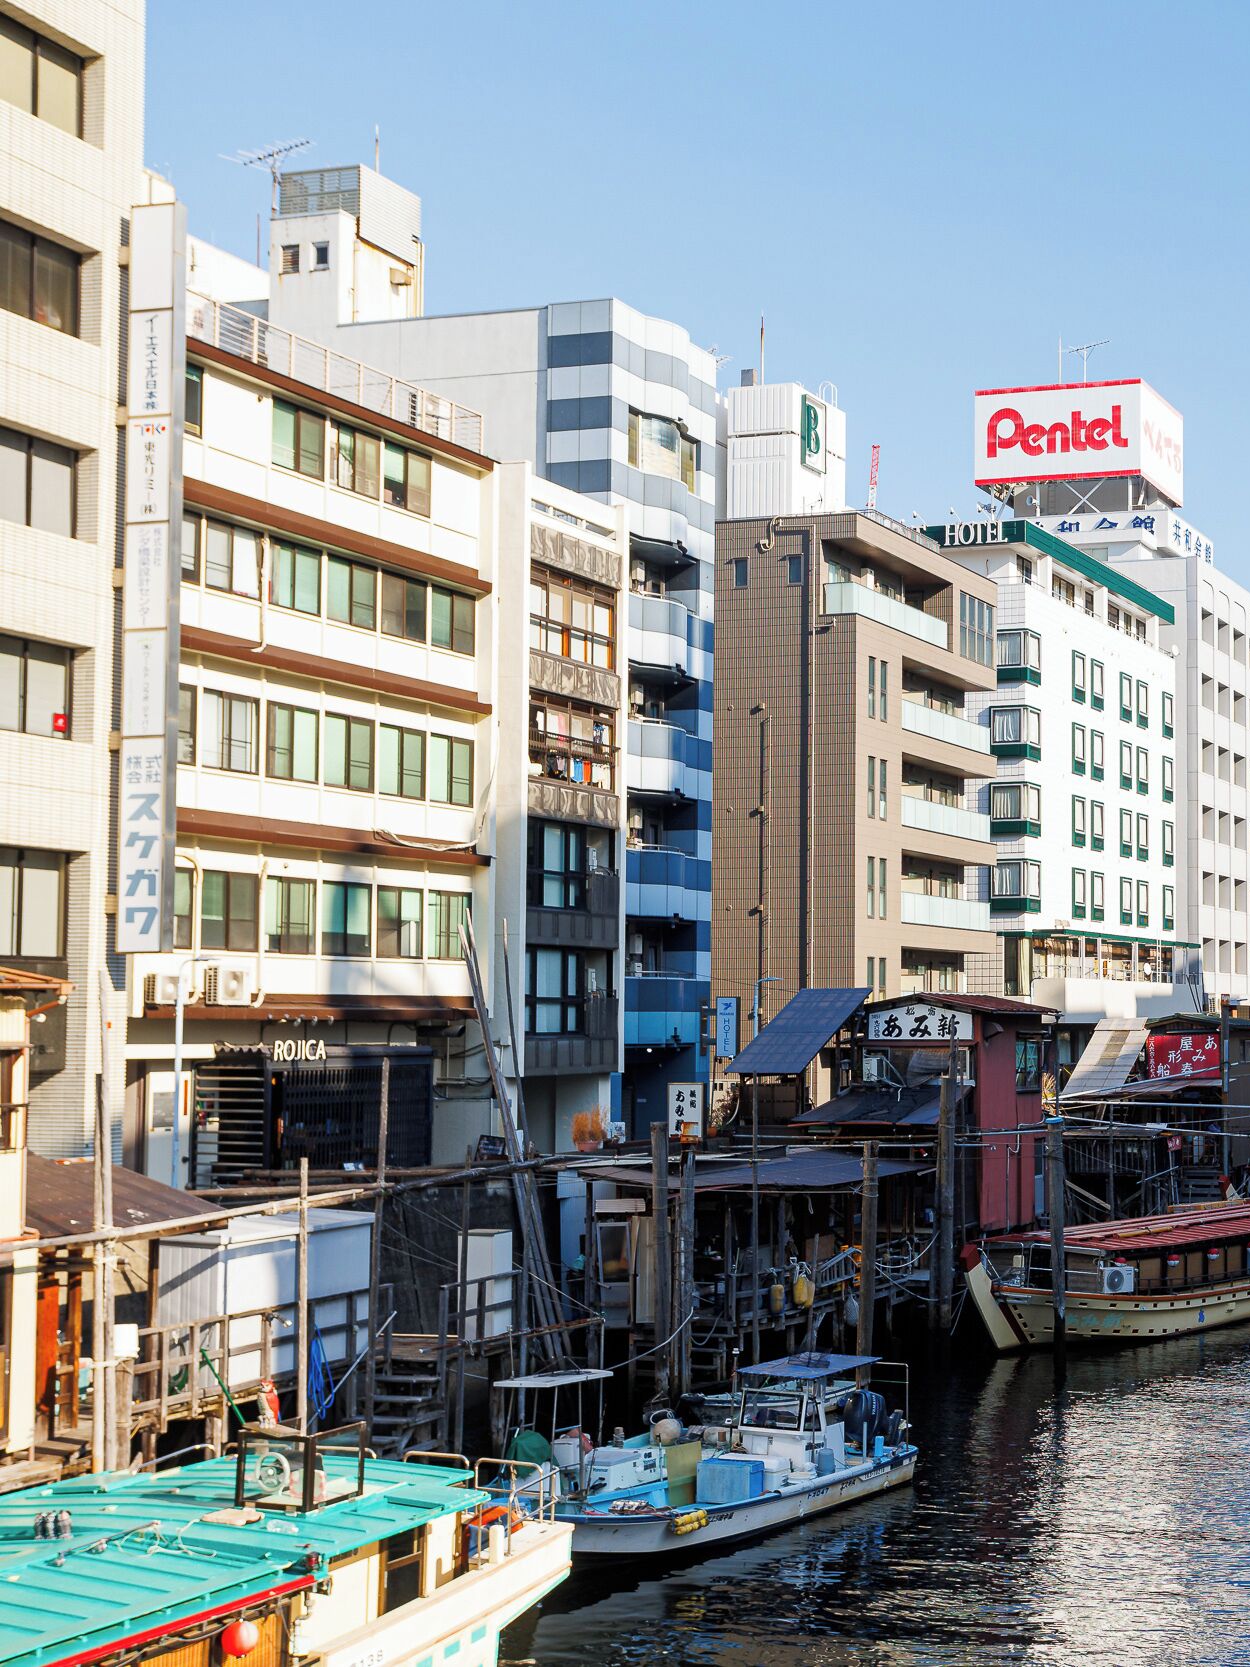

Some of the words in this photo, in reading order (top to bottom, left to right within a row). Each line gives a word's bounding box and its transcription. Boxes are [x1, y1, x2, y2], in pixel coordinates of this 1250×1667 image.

[987, 405, 1128, 458] Pentel
[944, 521, 1008, 546] HOTEL
[125, 793, 161, 935] スケガワ
[723, 1018, 731, 1051] HOTEL
[882, 1014, 960, 1038] あみ新
[273, 1040, 327, 1061] ROJICA
